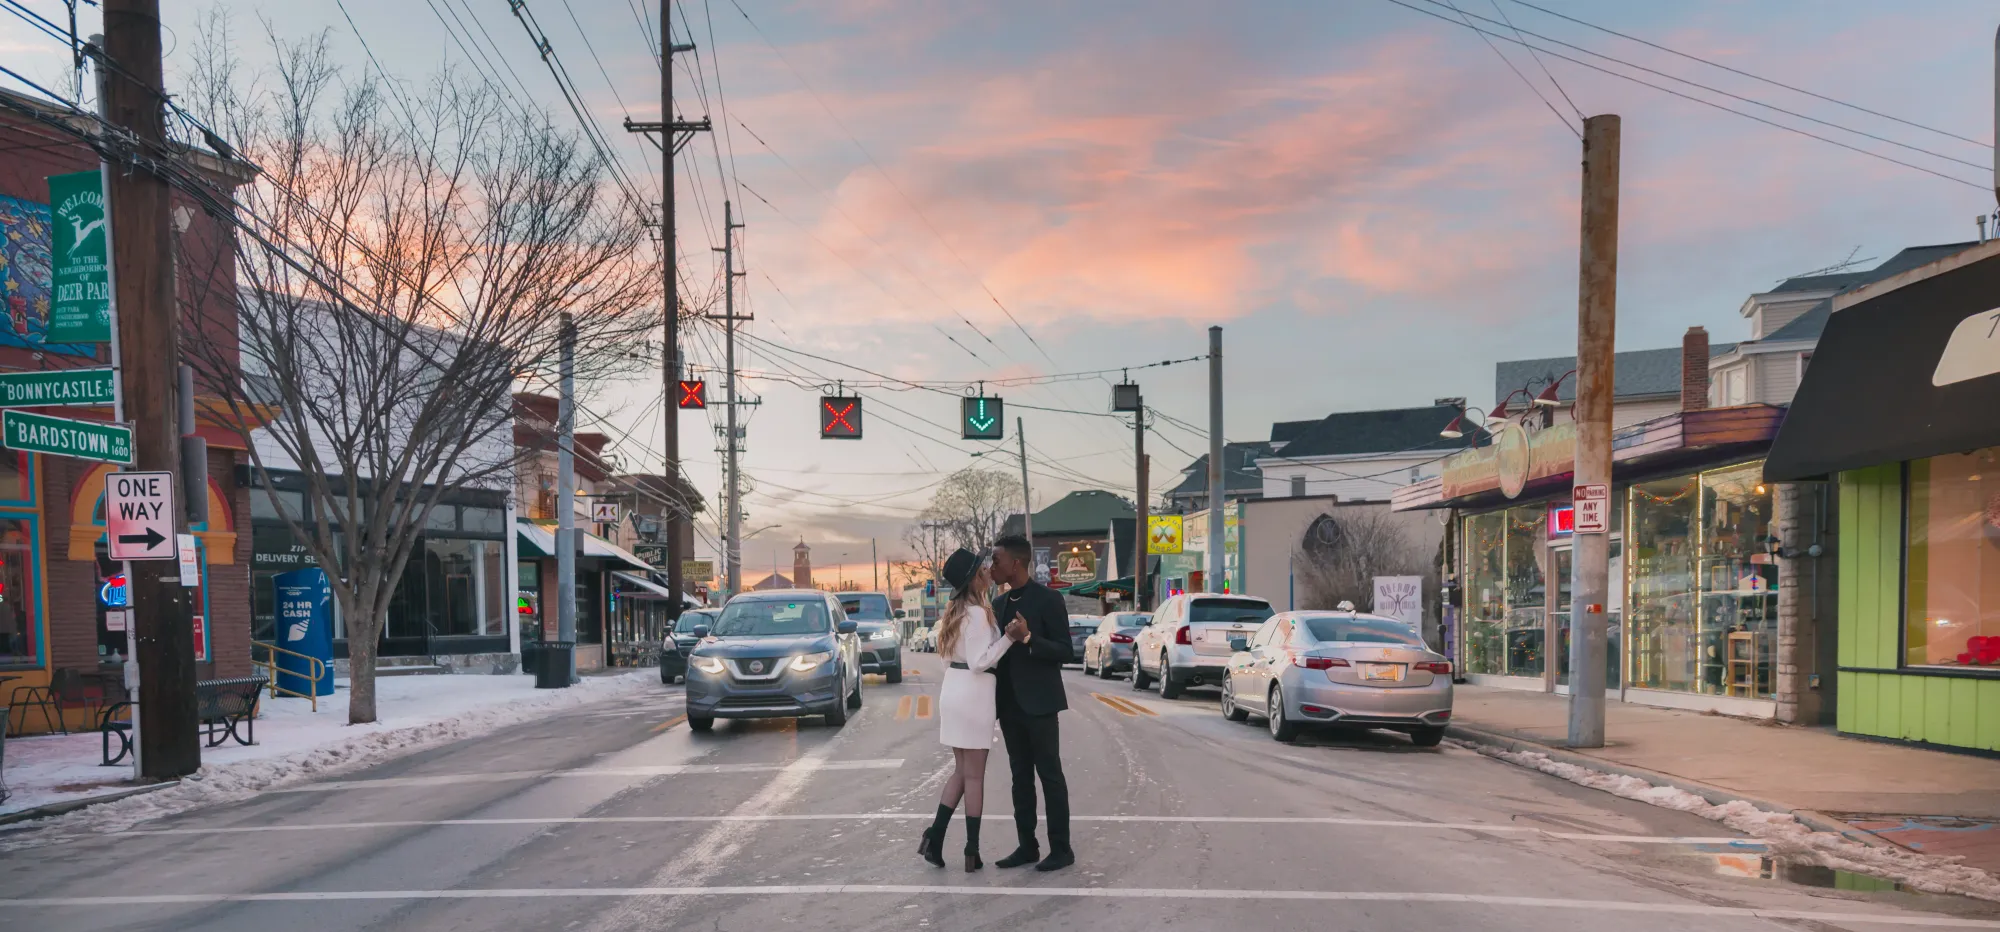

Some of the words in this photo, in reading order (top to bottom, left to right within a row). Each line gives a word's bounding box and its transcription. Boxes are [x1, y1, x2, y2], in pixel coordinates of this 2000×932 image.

[57, 190, 104, 217] WELCOM
[72, 257, 82, 265] TO
[83, 255, 99, 264] THE
[59, 264, 107, 276] NEIGHBORHO
[79, 272, 90, 281] OF
[57, 282, 84, 302] DEER
[86, 281, 109, 300] PAR
[7, 380, 103, 400] BONNYCASTLE
[18, 422, 108, 454] BARDSTOWN
[115, 436, 125, 446] RD
[111, 446, 129, 457] 1600
[118, 478, 160, 497] ONE
[1575, 488, 1586, 498] NO
[1586, 488, 1605, 496] PARKING
[119, 502, 163, 521] WAY
[1583, 502, 1598, 511] ANY
[1582, 513, 1599, 522] TIME
[255, 553, 299, 563] DELIVERY
[636, 547, 662, 560] PUBLIC
[1380, 583, 1416, 596] DREAMS
[283, 601, 294, 609] 24
[296, 601, 312, 609] HR
[282, 610, 311, 618] CASH
